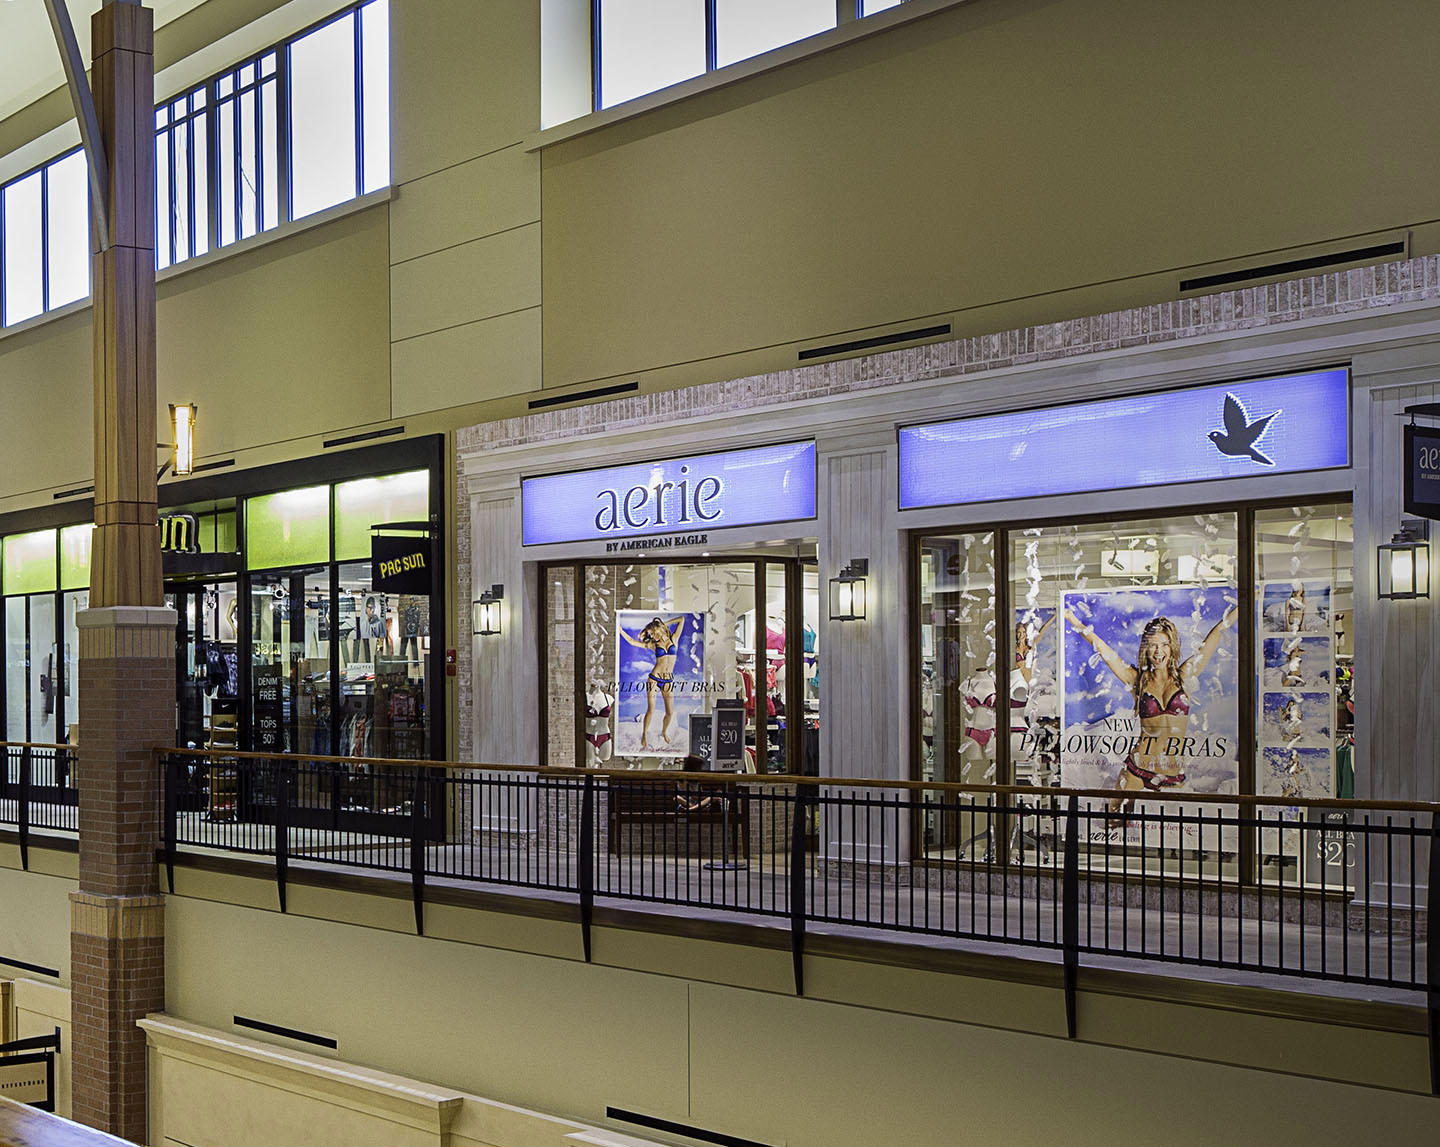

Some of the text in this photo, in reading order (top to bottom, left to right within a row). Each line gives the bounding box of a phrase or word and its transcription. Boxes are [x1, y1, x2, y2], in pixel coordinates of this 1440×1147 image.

[595, 465, 721, 531] aerie
[606, 534, 708, 552] BY AMERICAN EAGLE
[380, 558, 402, 579] PAC
[257, 677, 278, 686] DENIM
[692, 681, 725, 693] BRAS
[259, 691, 277, 700] FREE
[260, 720, 277, 728] TOPS
[1102, 718, 1137, 732] NEW
[720, 729, 738, 744] $20
[1165, 736, 1228, 758] BRAS
